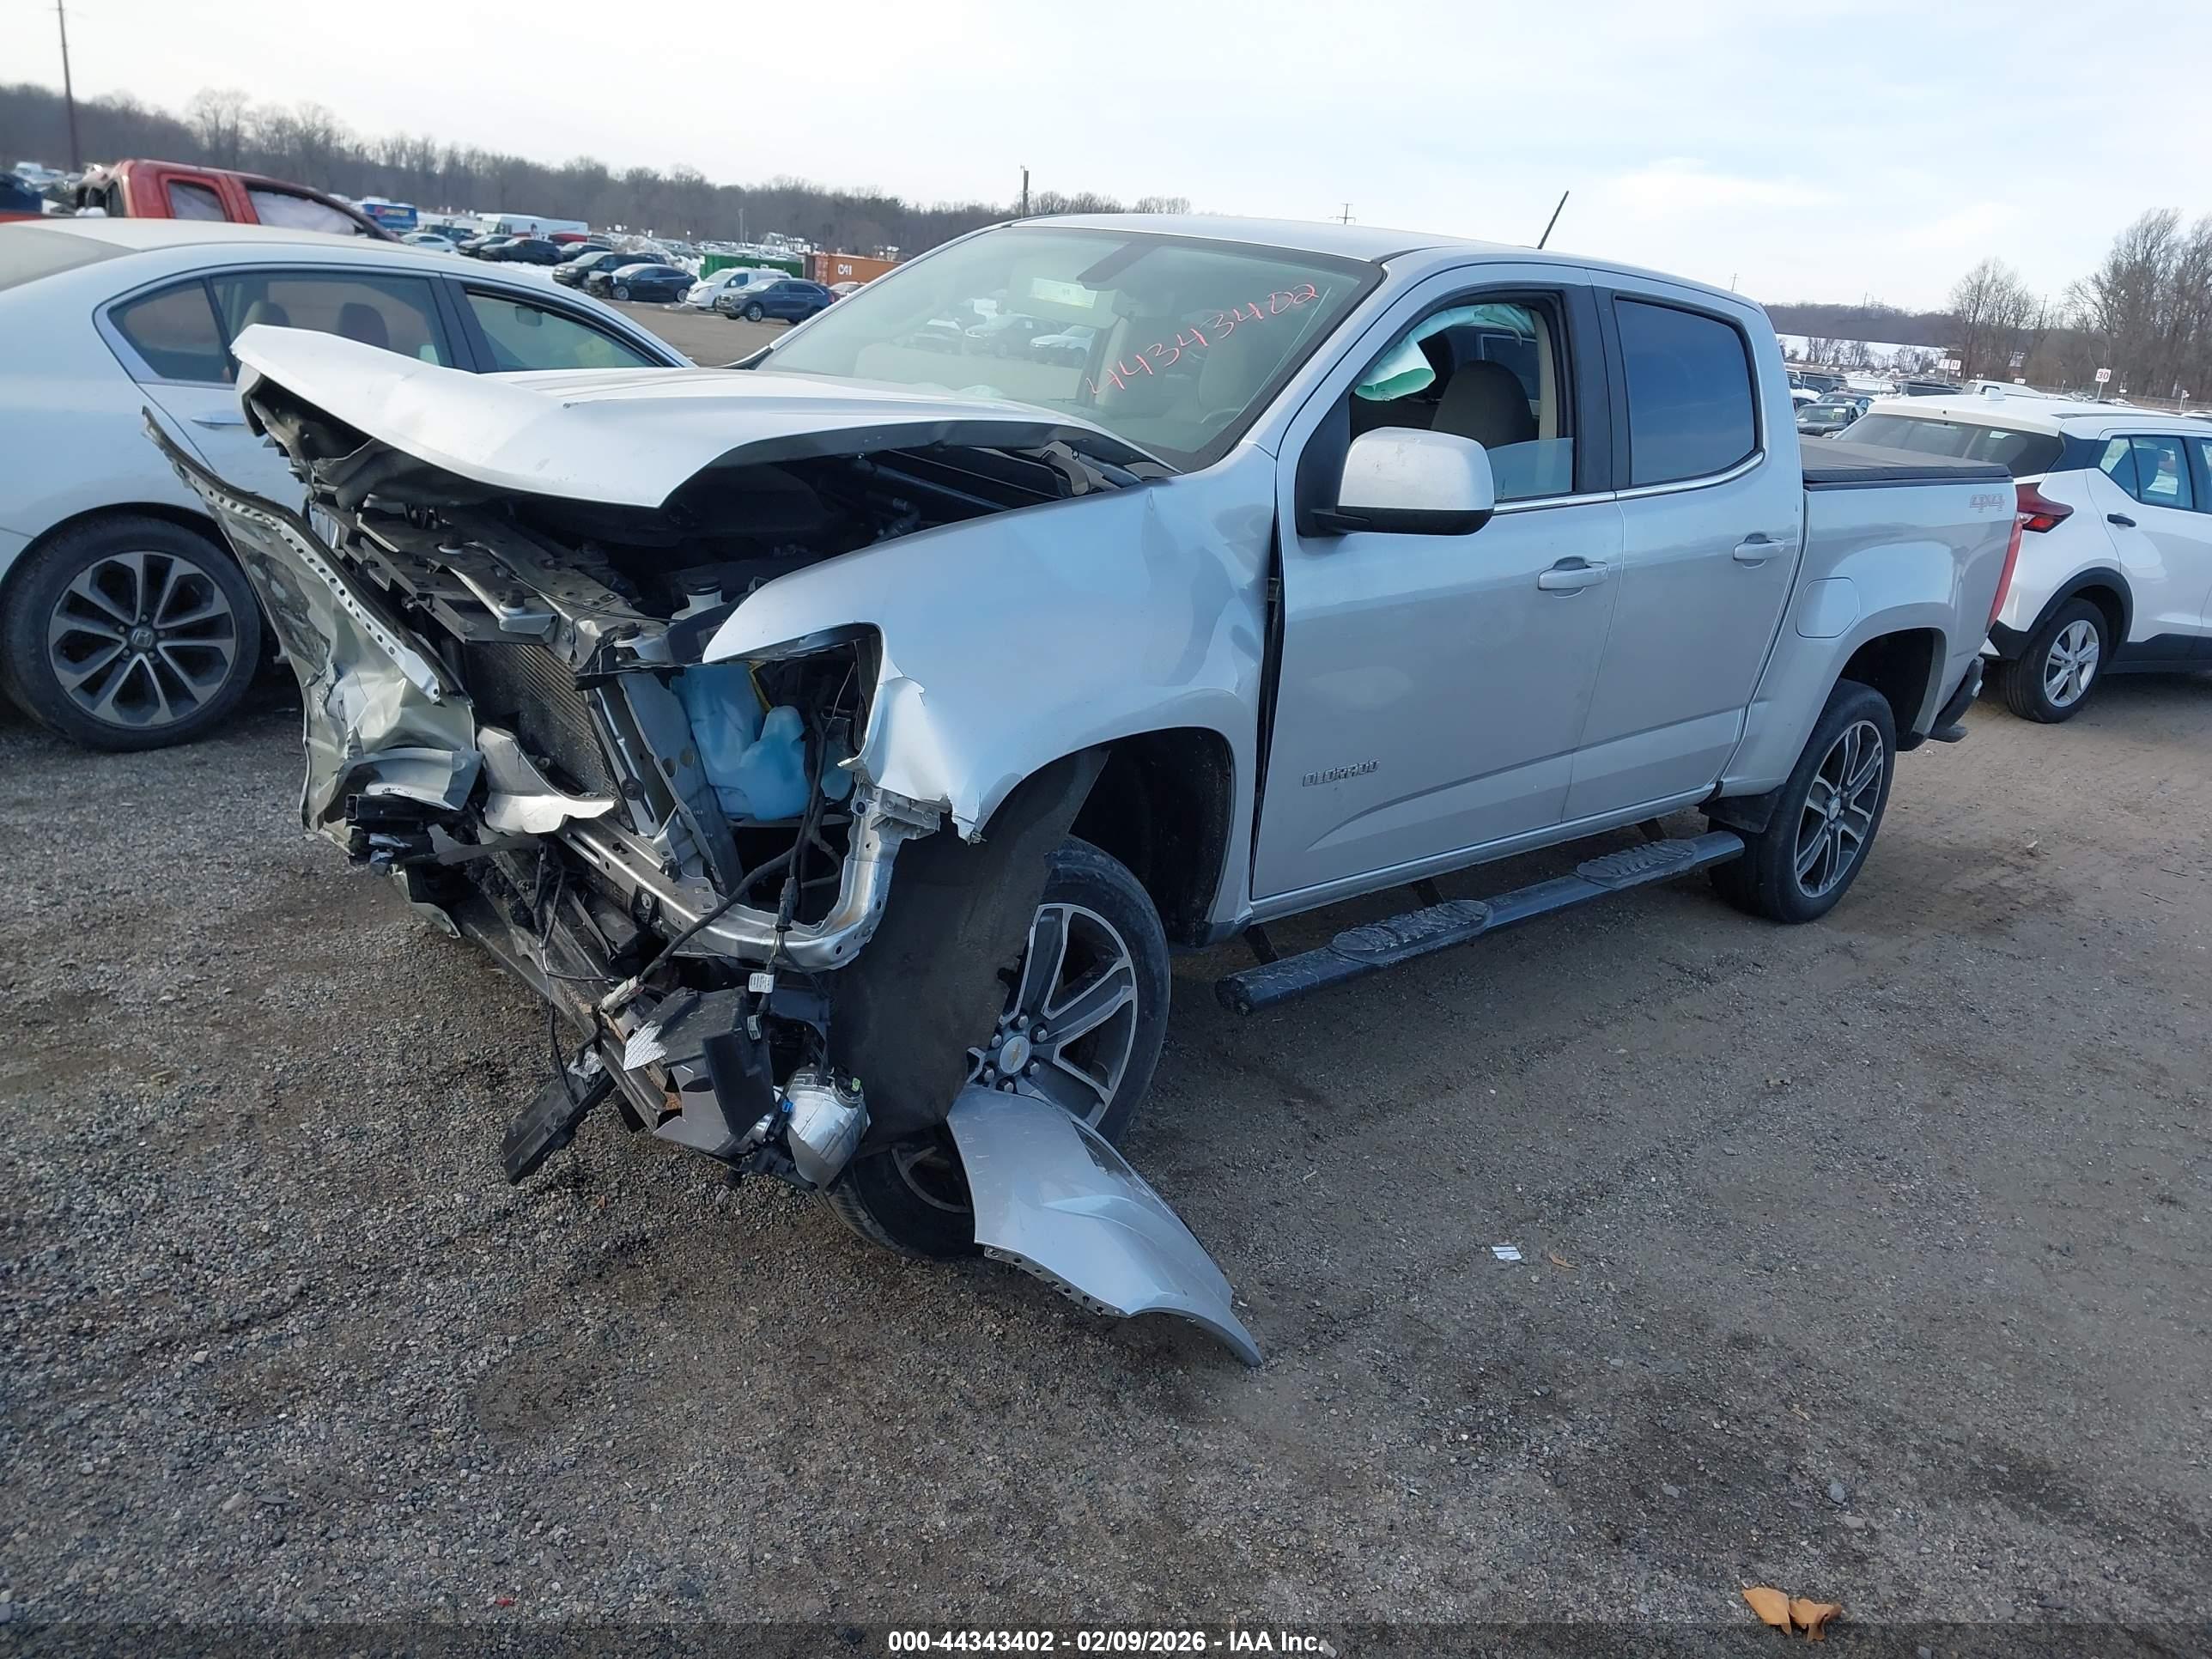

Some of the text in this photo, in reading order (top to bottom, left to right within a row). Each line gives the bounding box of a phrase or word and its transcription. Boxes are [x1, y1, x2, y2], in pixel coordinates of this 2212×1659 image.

[837, 264, 852, 276] CAI
[1085, 283, 1320, 395] 44343402
[2097, 371, 2109, 380] 30
